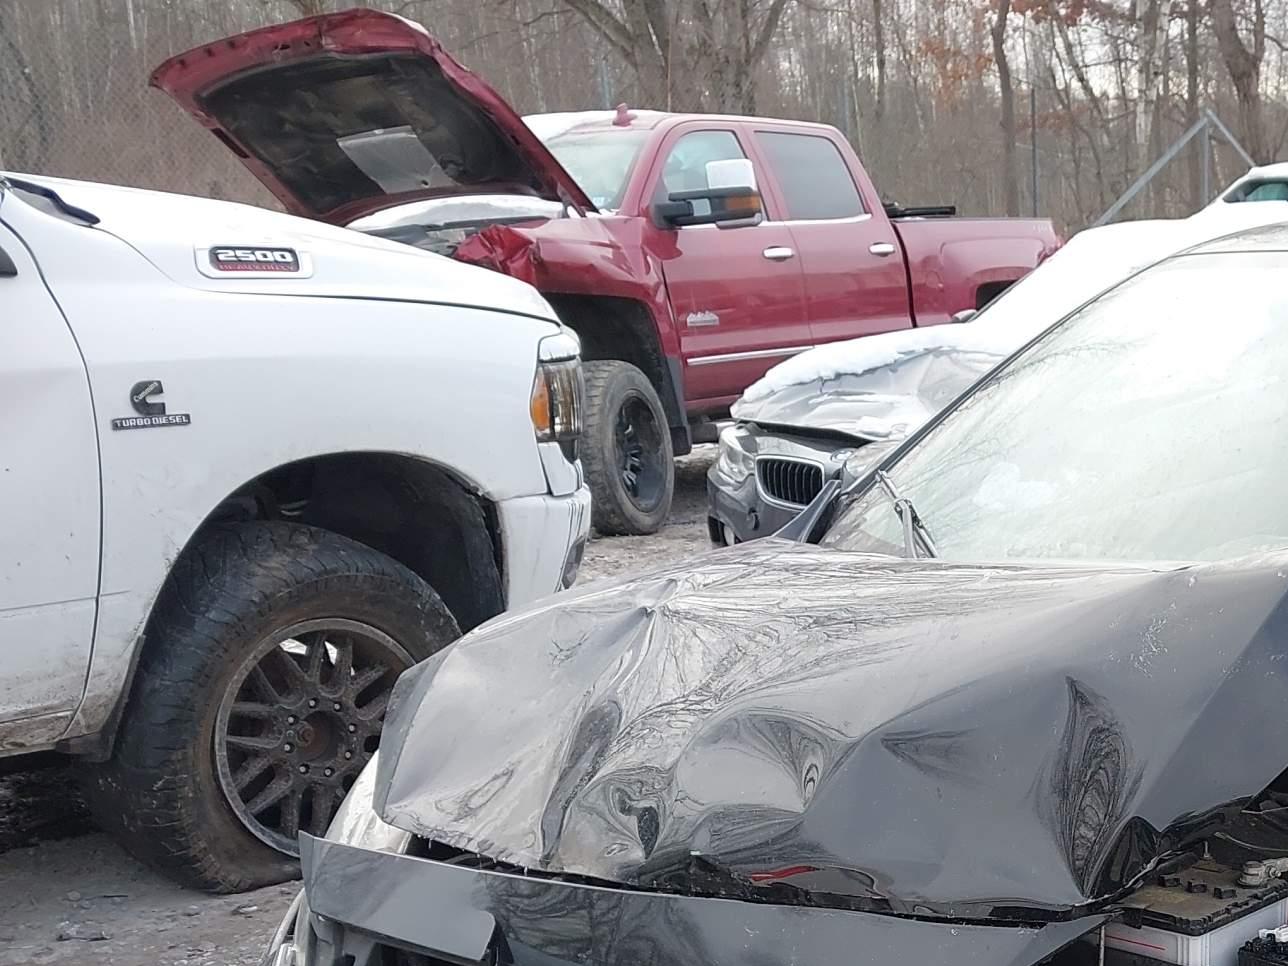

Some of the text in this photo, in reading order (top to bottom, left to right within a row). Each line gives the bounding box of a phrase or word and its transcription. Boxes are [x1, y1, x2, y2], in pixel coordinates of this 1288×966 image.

[215, 249, 294, 263] 2500
[115, 415, 189, 428] TURBO DIESEL
